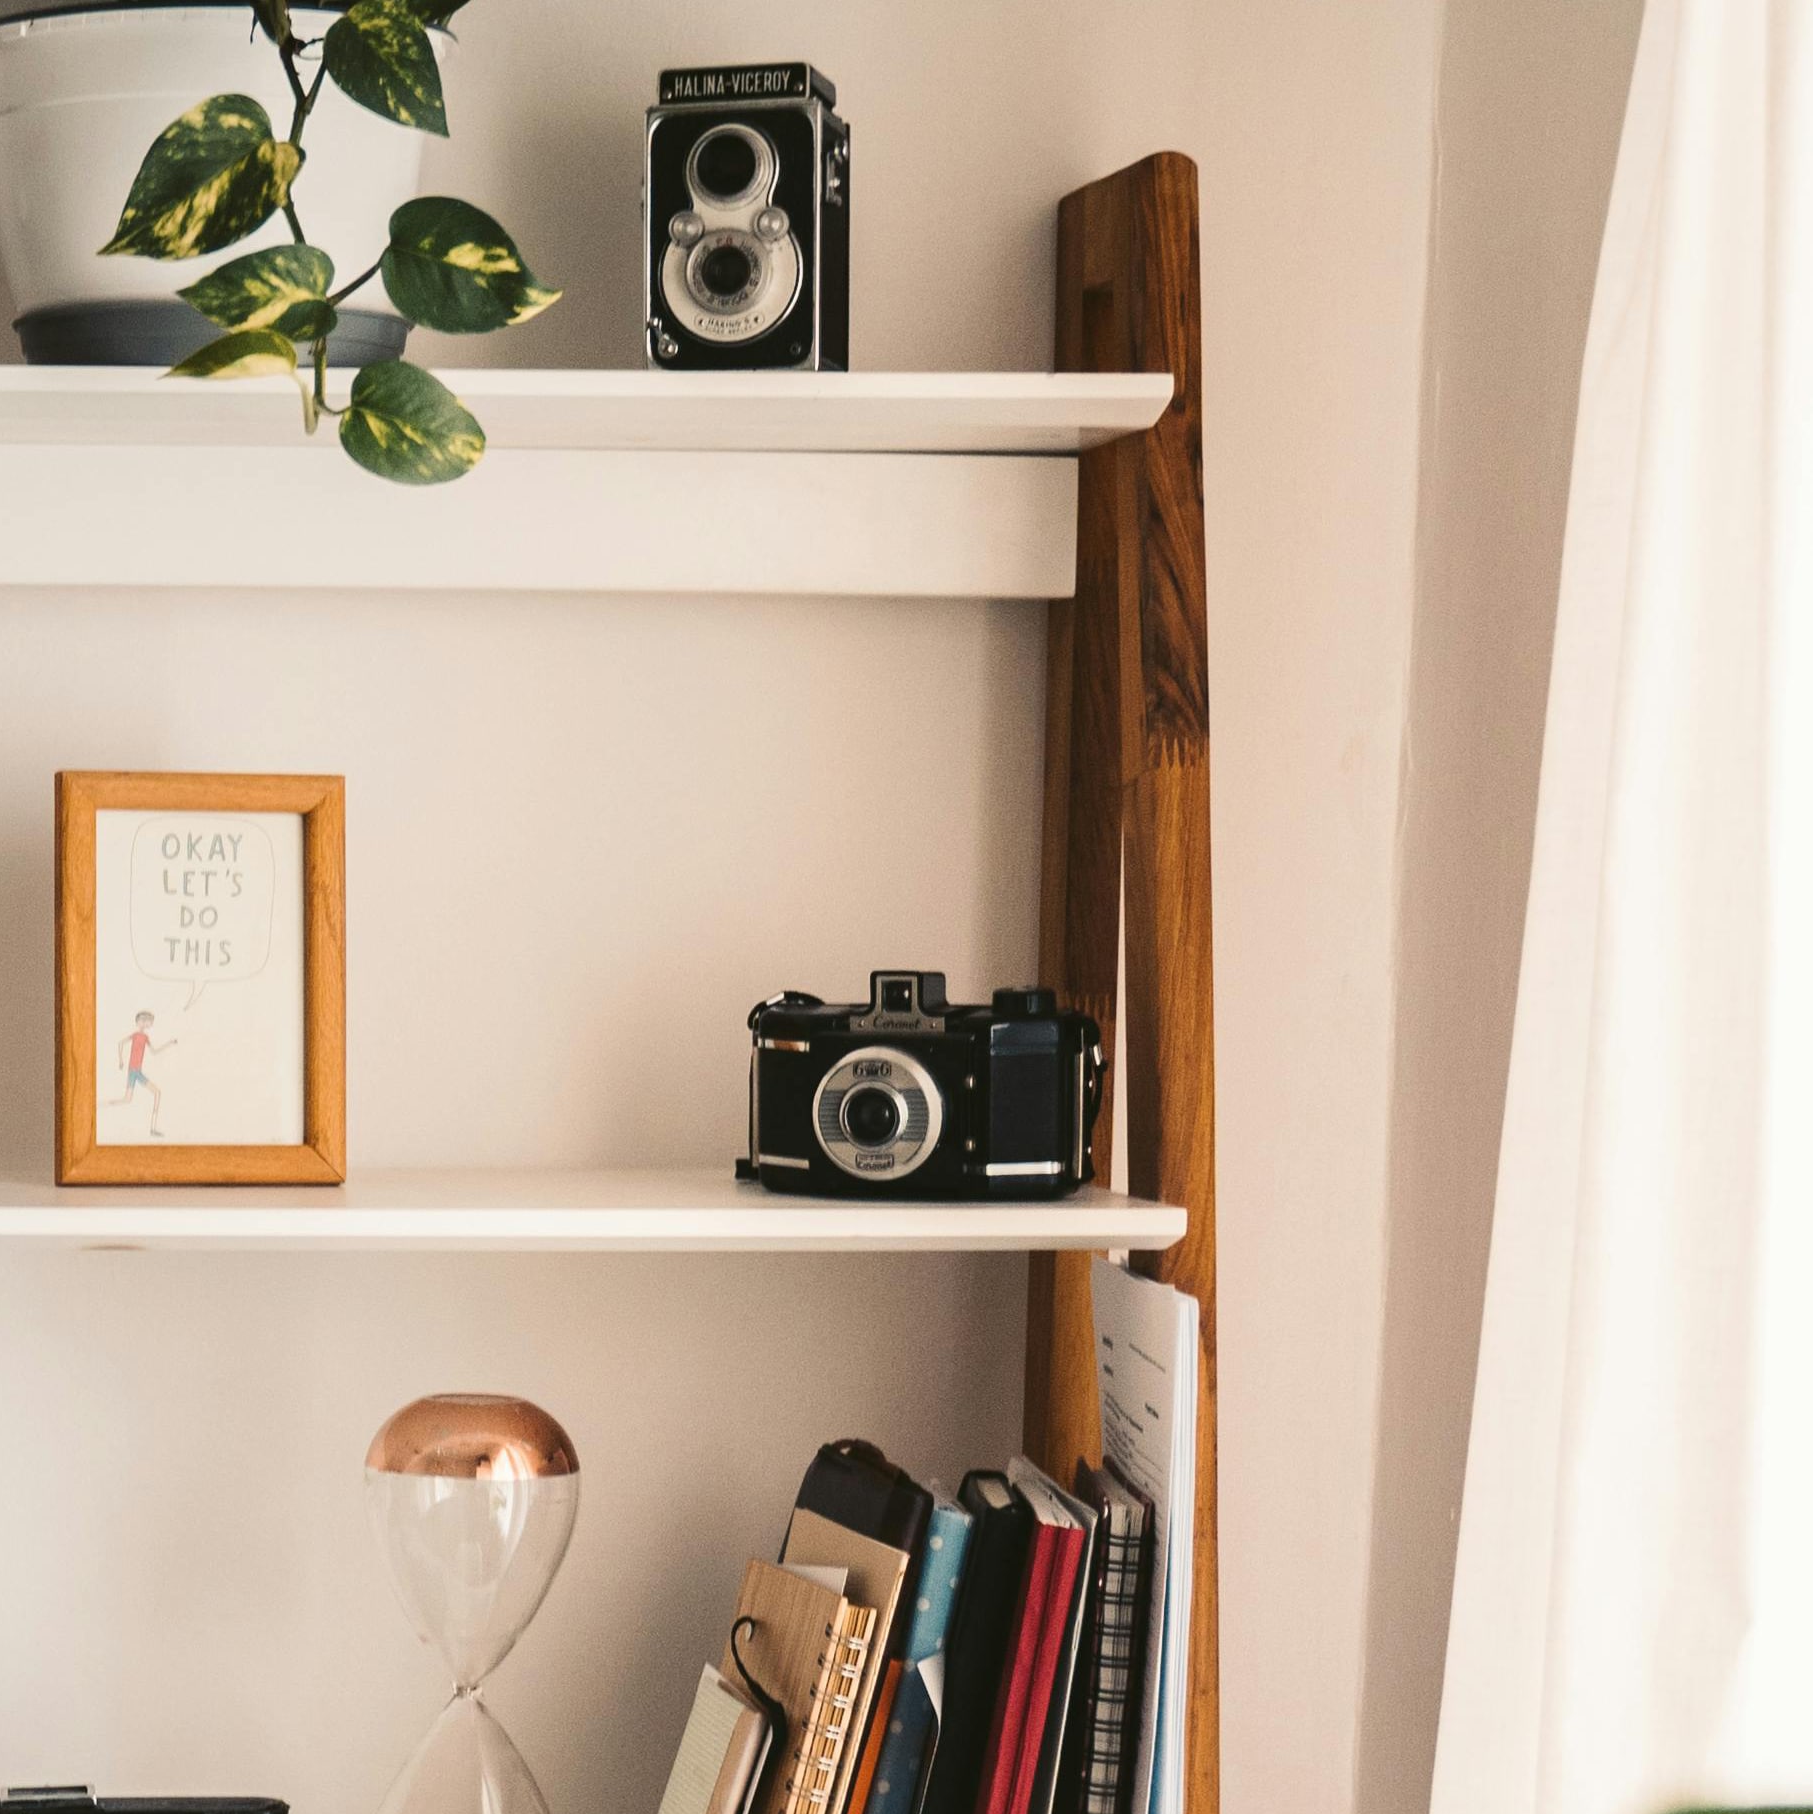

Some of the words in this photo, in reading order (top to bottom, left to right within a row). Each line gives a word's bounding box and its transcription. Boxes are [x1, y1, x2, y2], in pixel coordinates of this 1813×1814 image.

[674, 70, 791, 98] HALINA-VICEROY
[160, 832, 244, 864] OKAY
[162, 870, 243, 898] LET'S
[179, 905, 219, 929] DO
[163, 938, 232, 967] THIS
[873, 1015, 921, 1031] Coronet
